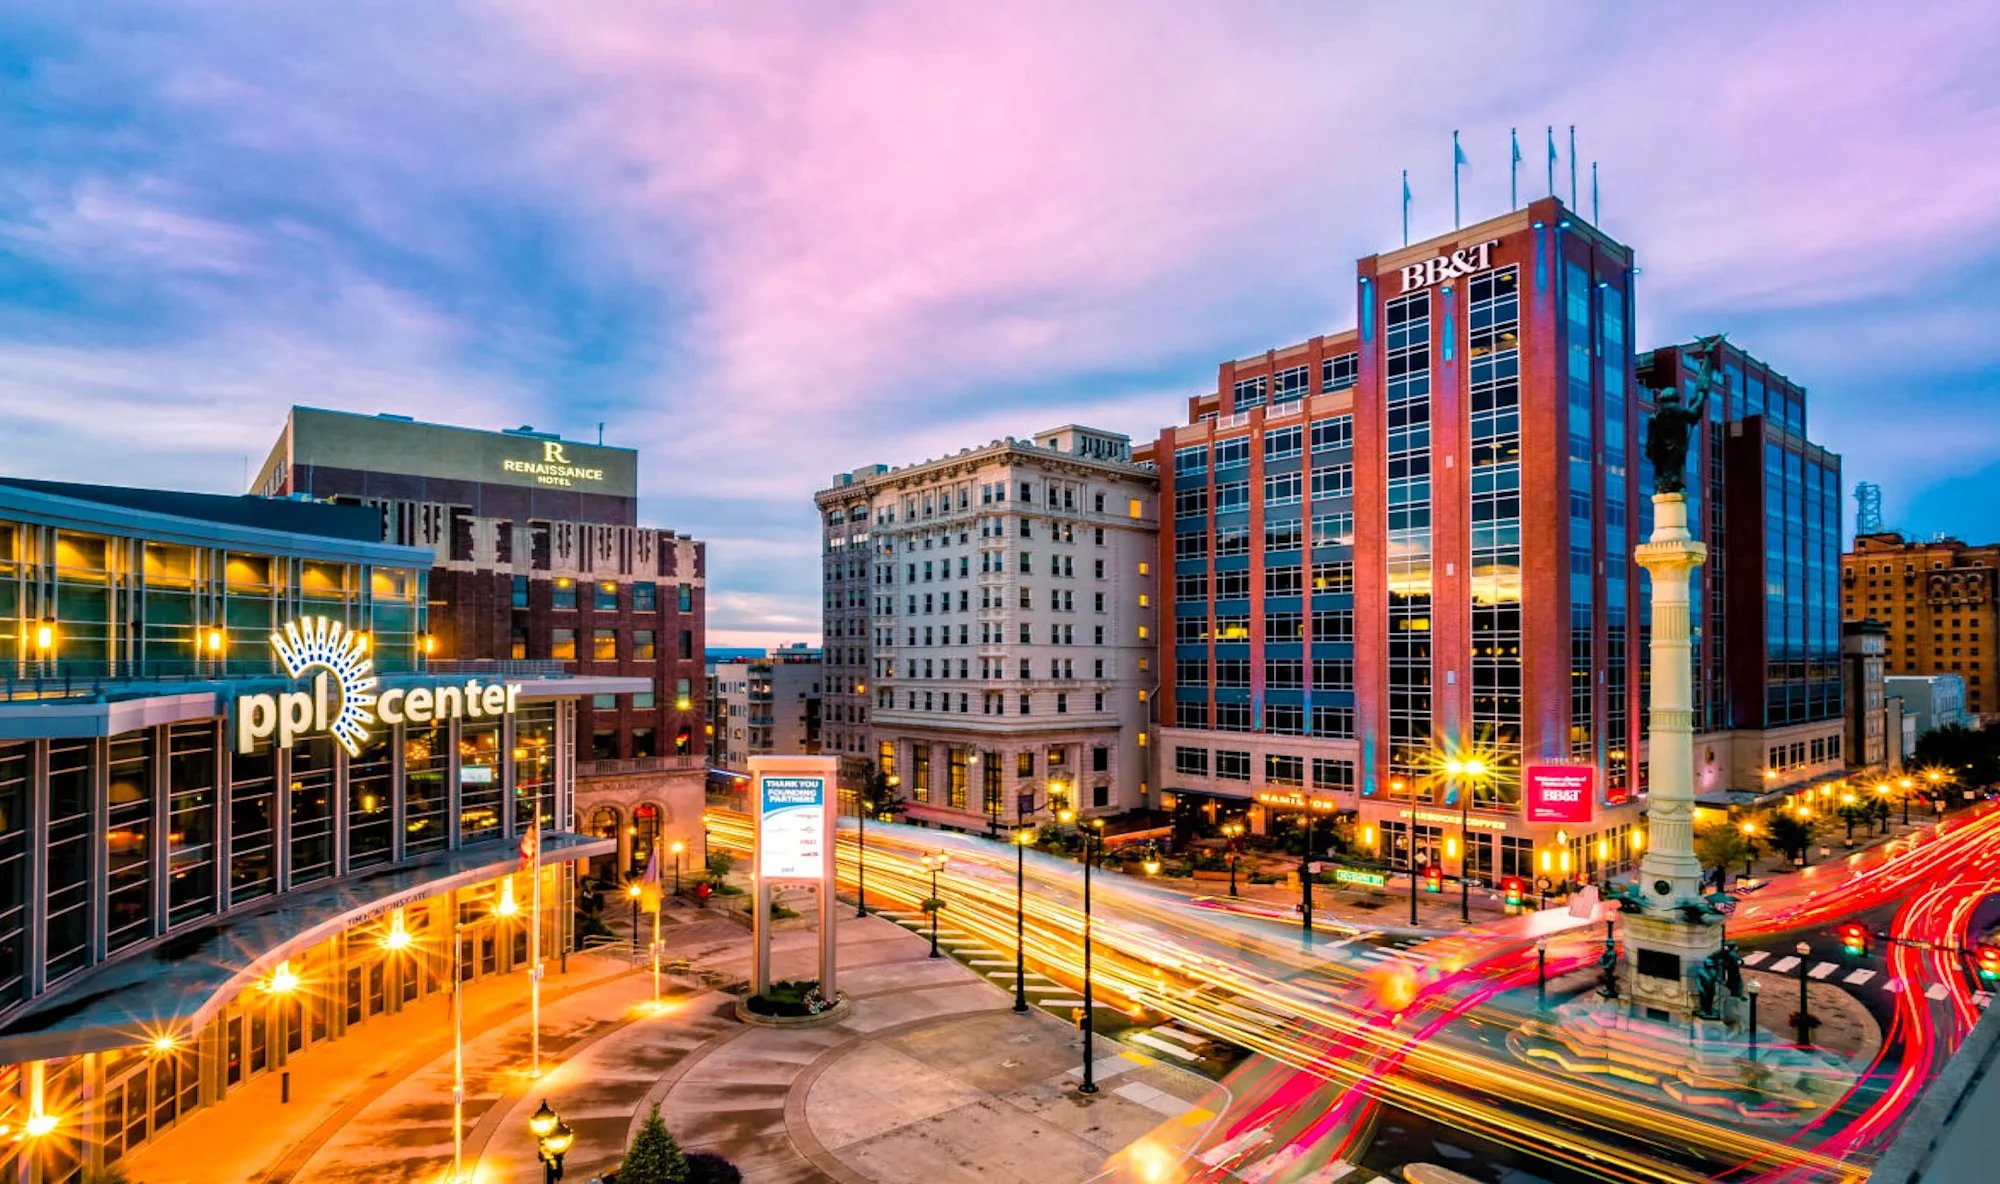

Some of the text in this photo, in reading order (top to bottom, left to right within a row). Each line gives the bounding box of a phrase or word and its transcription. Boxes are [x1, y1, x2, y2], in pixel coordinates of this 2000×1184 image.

[1400, 239, 1499, 293] BB&T
[543, 441, 571, 464] R
[503, 460, 604, 481] RENAISSANCE
[538, 475, 572, 487] HOTEL
[239, 670, 522, 754] ppl center
[766, 780, 819, 788] THANK YOU
[1260, 793, 1333, 809] HAMILON
[1543, 789, 1582, 802] BB&T
